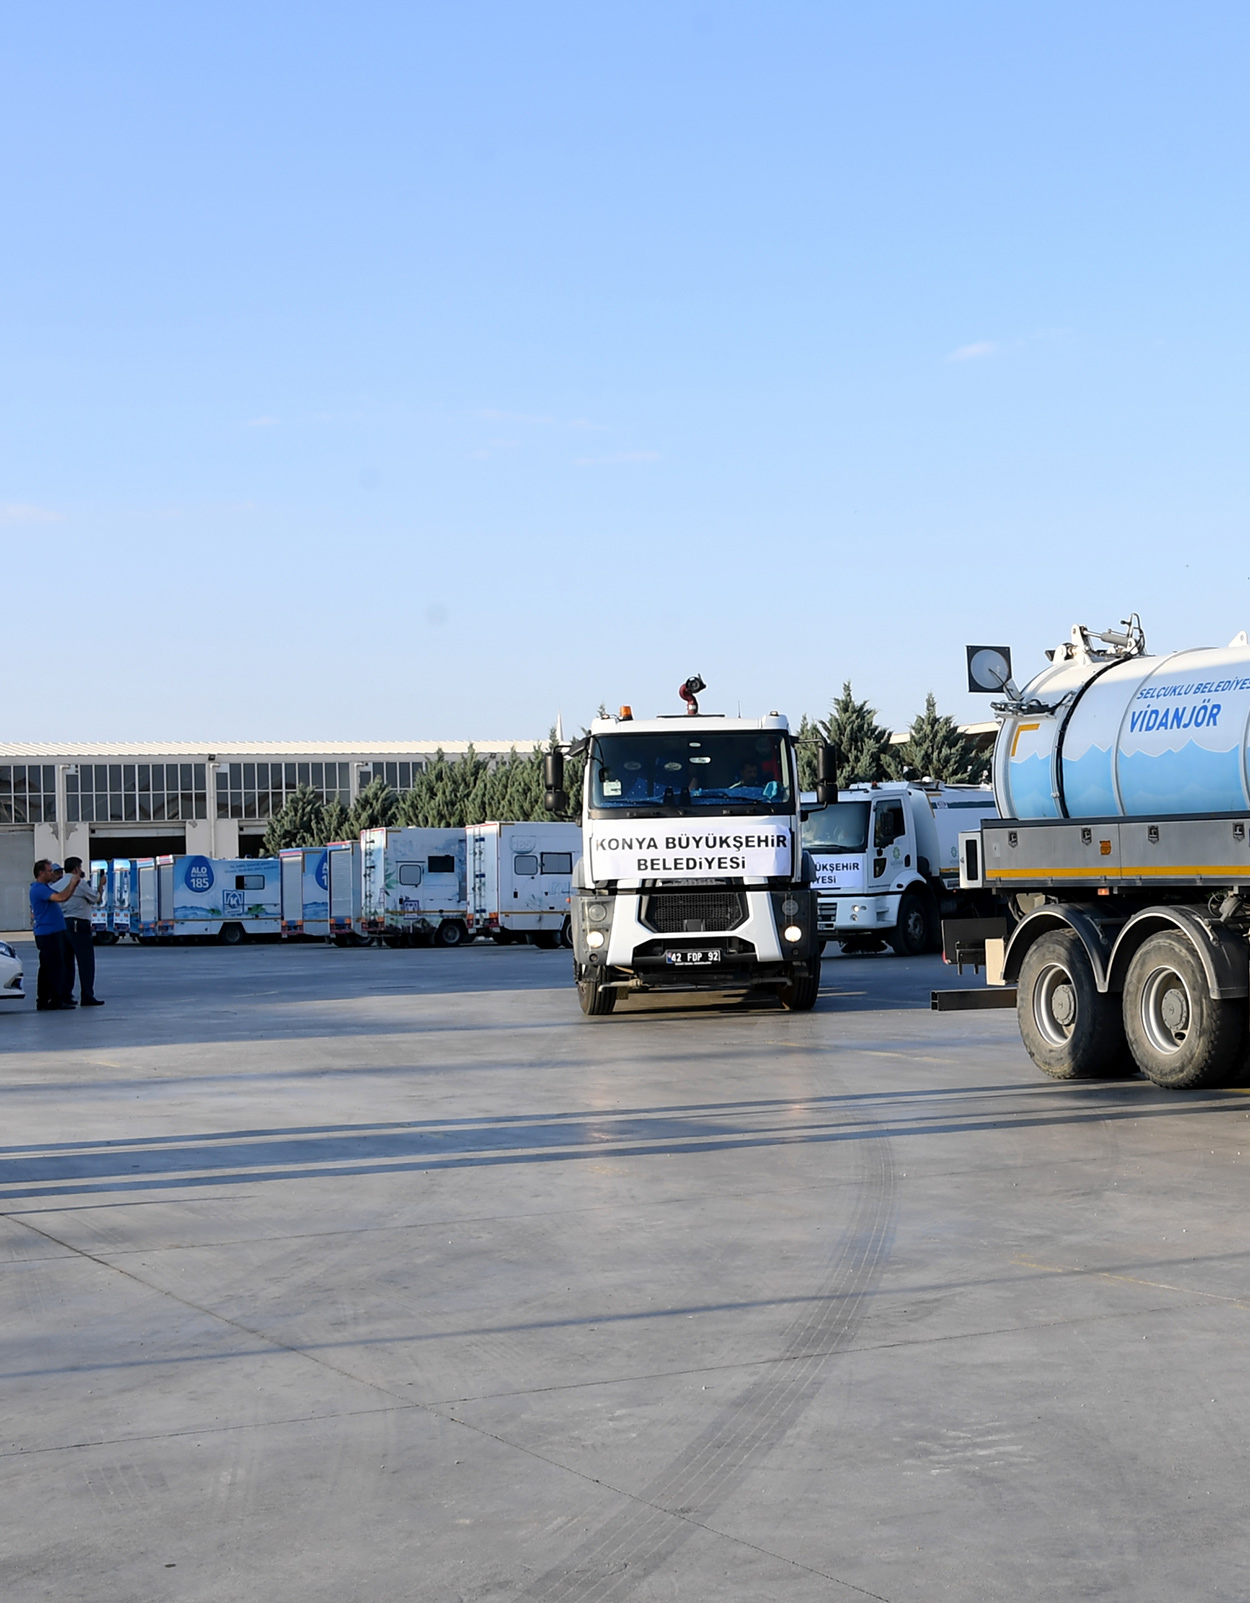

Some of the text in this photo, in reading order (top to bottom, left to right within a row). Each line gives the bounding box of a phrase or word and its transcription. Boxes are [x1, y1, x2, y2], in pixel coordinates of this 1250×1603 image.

[1136, 683, 1195, 700] SELÇUKLU
[1129, 698, 1222, 733] VİDANJÖR
[596, 837, 659, 851] KONYA
[191, 866, 207, 874] ALO
[190, 877, 210, 888] 185
[671, 951, 719, 962] 42 FDP 92
